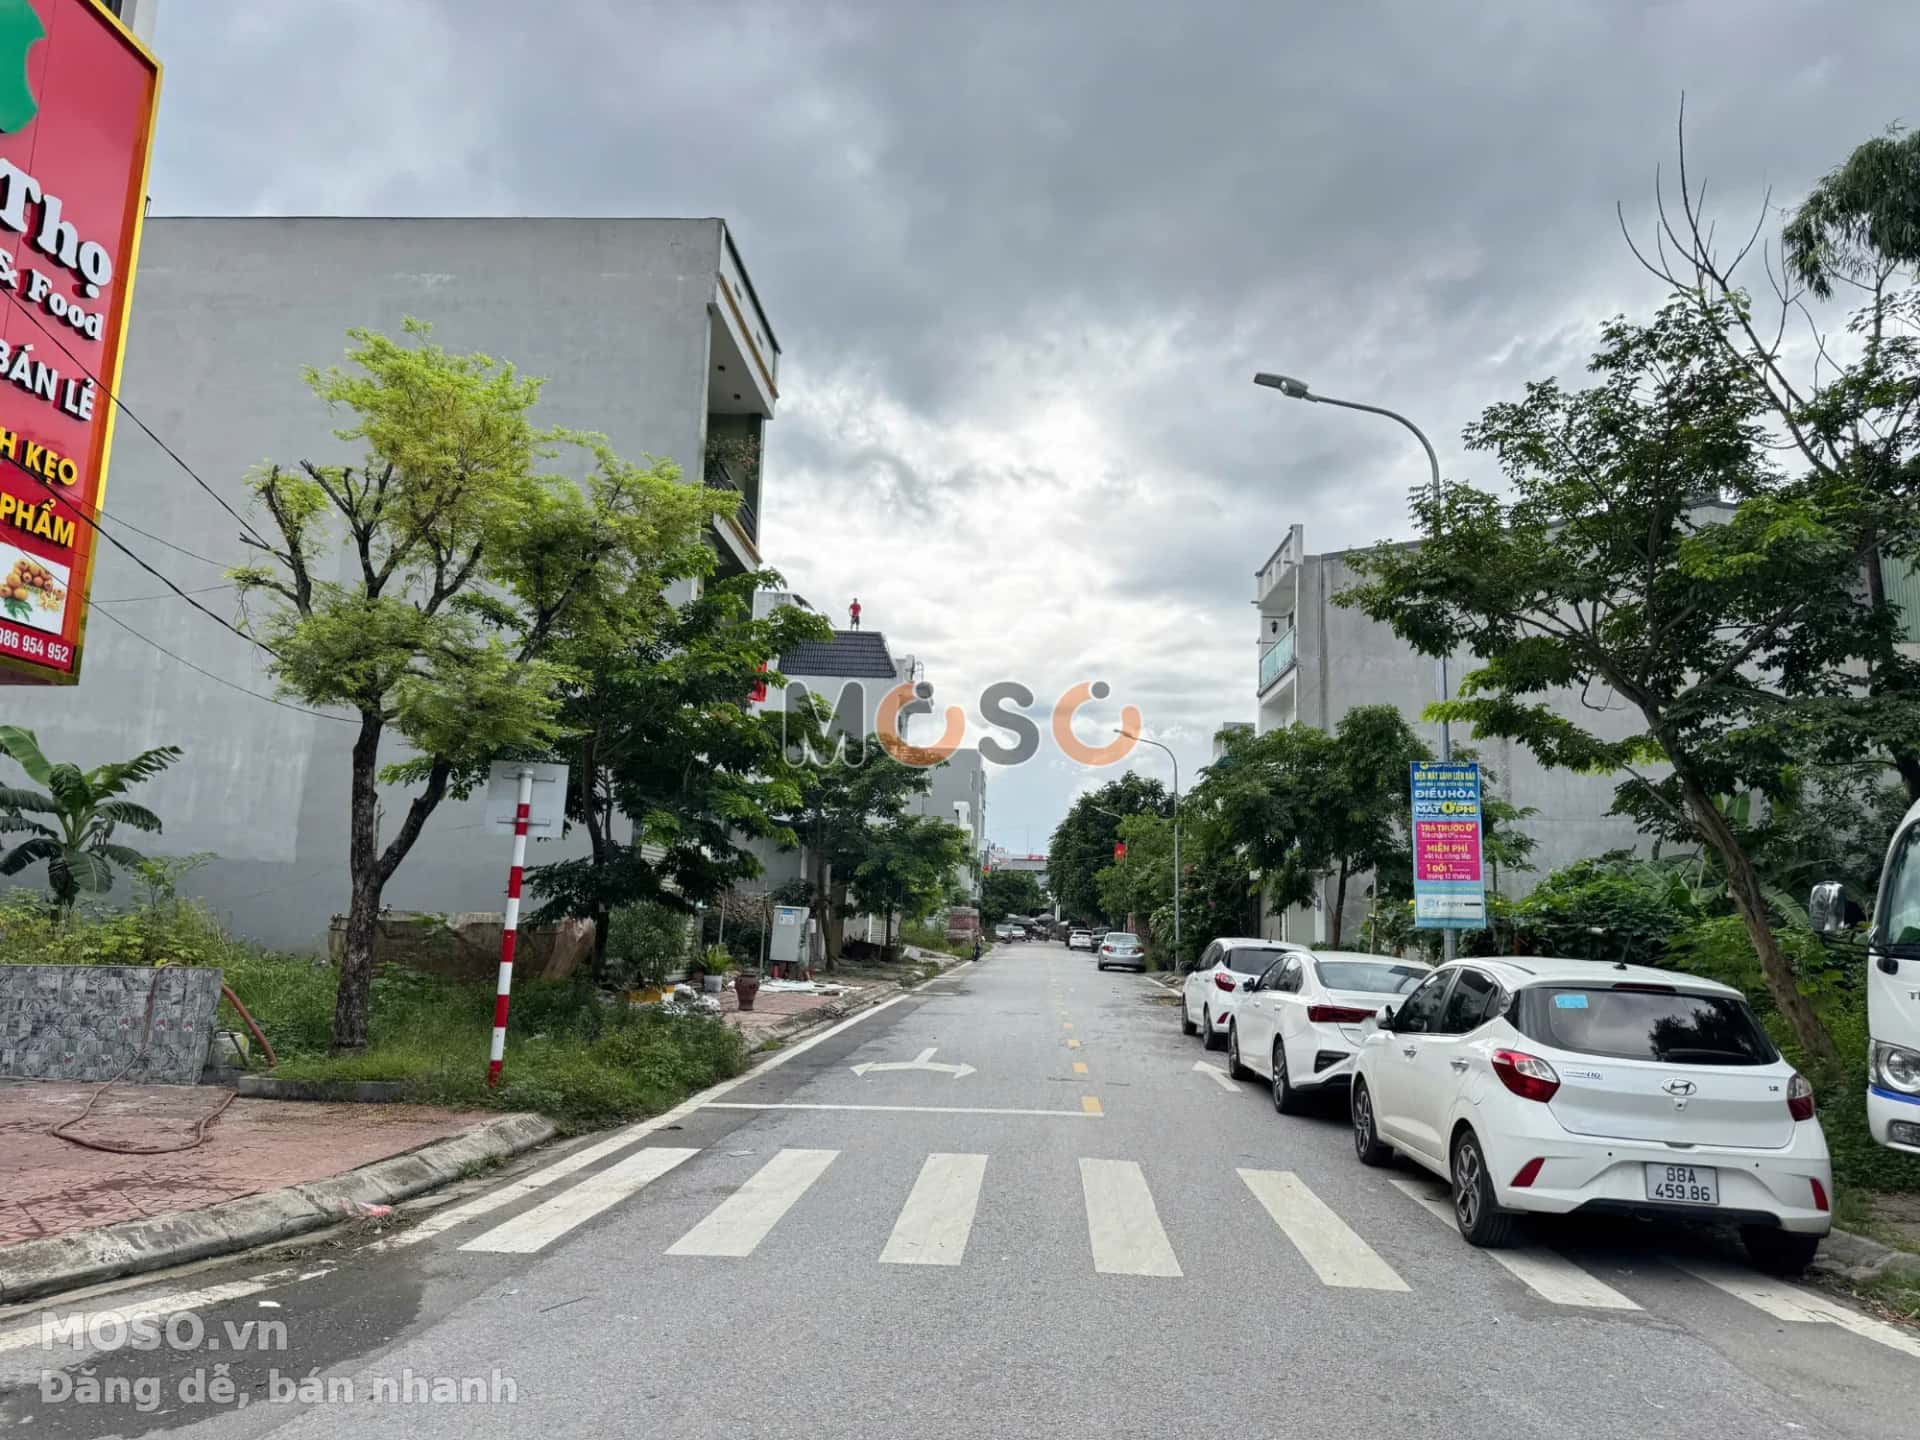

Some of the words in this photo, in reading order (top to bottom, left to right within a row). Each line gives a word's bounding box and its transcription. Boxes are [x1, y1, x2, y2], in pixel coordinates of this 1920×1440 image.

[0, 158, 112, 298] Thọ
[28, 269, 103, 341] Food
[65, 377, 96, 421] LẺ
[25, 440, 78, 486] KẸO
[0, 492, 75, 548] PHẨM
[22, 635, 44, 657] 954
[47, 642, 69, 663] 952
[1655, 1183, 1711, 1201] 459.86
[1666, 1167, 1697, 1184] 88A
